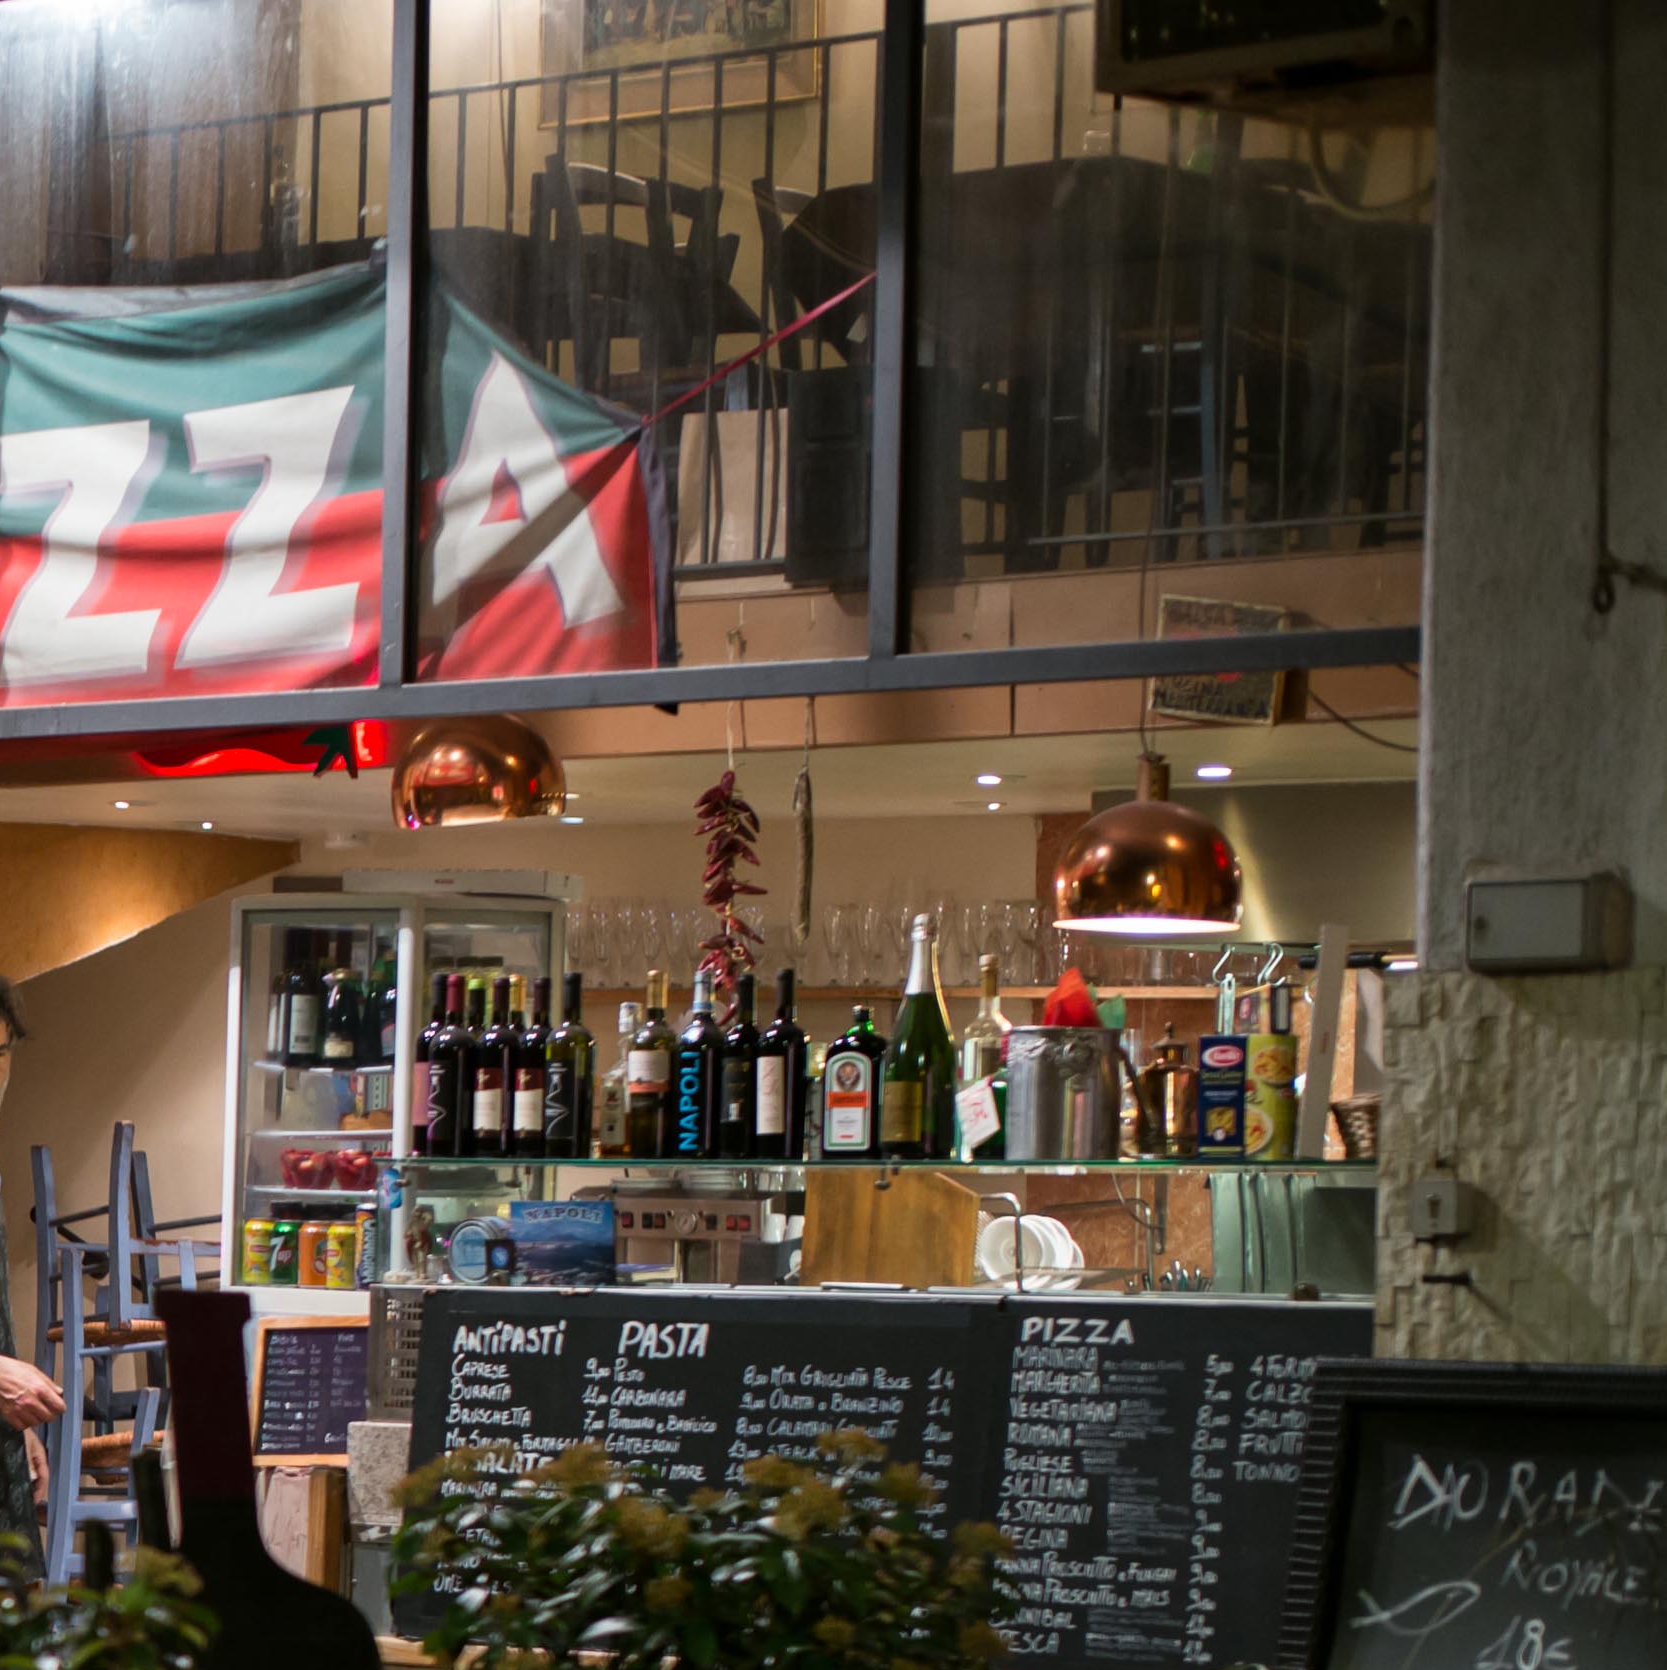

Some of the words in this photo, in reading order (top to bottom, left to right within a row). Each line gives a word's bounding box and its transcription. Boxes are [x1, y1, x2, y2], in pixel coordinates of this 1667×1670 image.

[678, 1051, 701, 1151] NAPOLI
[523, 1205, 604, 1225] NAPOLI
[617, 1319, 710, 1360] PASTA
[1020, 1316, 1135, 1346] PIZZA
[450, 1352, 511, 1381] CAPRESE
[613, 1356, 646, 1383] PESTO
[873, 1366, 914, 1390] PESCE
[927, 1365, 956, 1391] 14
[447, 1376, 513, 1402] BURRATA
[609, 1385, 687, 1409] CARBONARA
[768, 1387, 815, 1411] ORATA
[925, 1395, 952, 1417] 14
[444, 1402, 534, 1428] BRUSCHETTA
